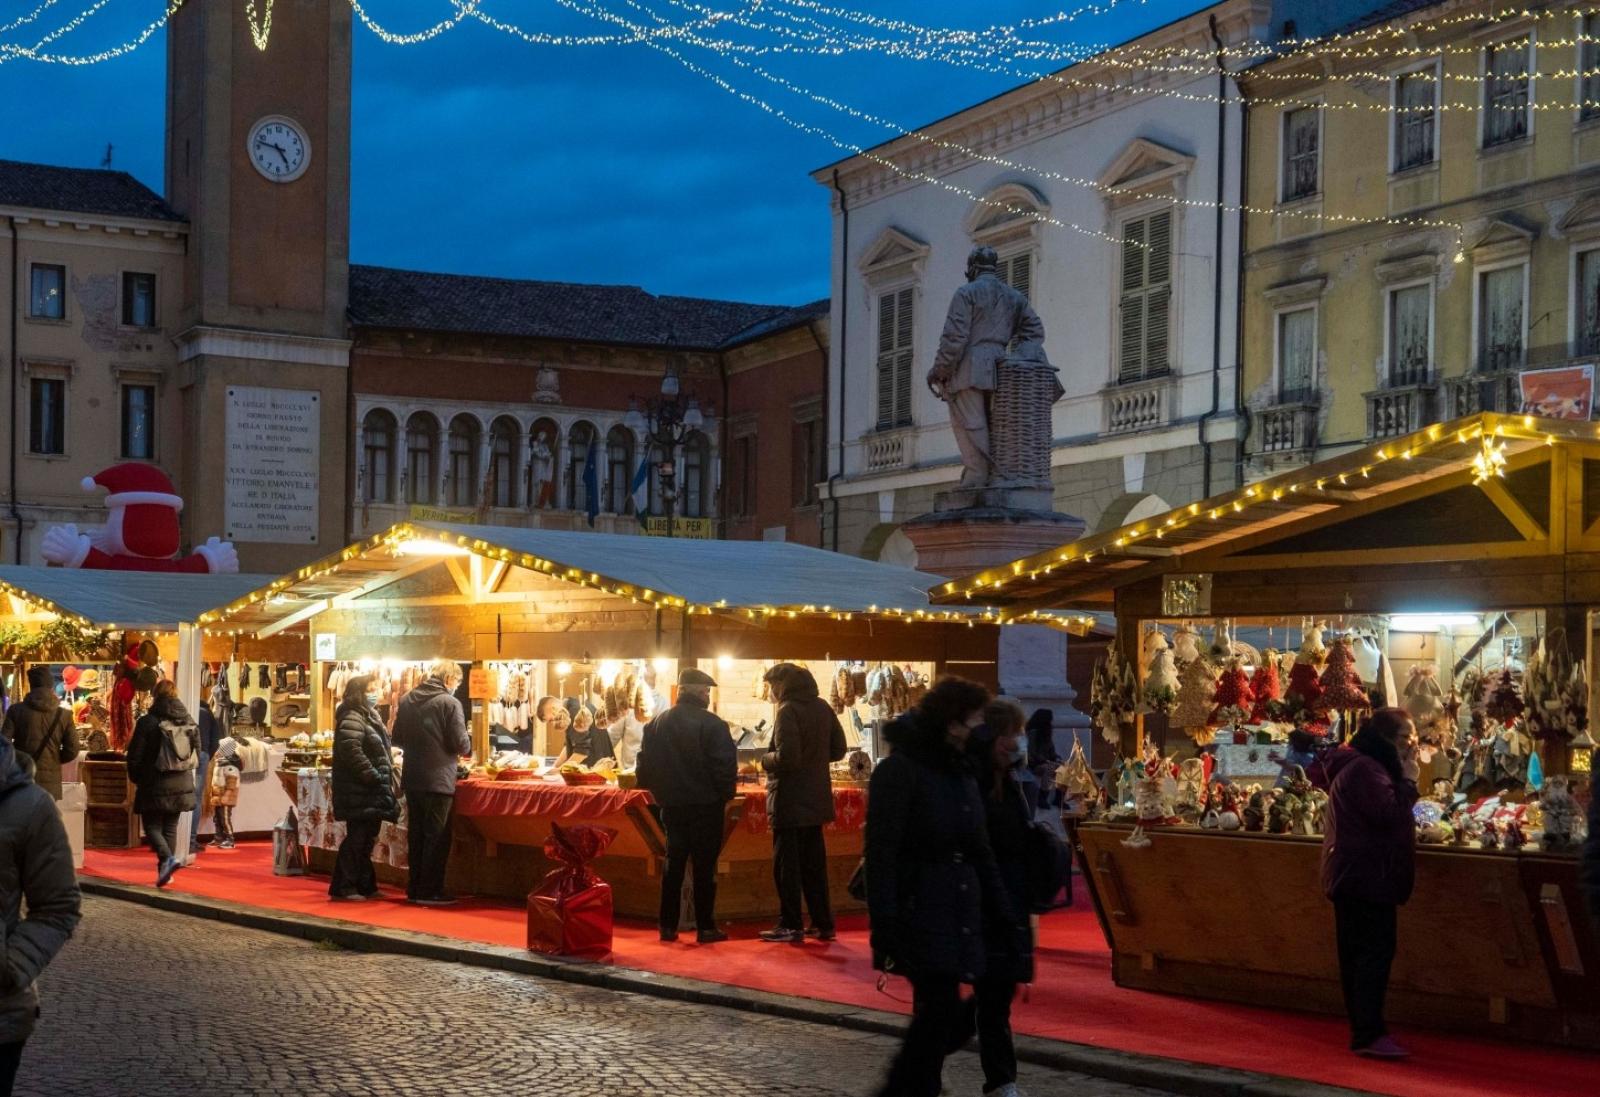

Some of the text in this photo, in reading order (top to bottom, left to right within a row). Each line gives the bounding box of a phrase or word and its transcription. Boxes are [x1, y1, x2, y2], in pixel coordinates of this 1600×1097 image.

[275, 413, 303, 421] FAUSTO
[238, 422, 260, 430] DELLA
[249, 468, 274, 476] LUGLIO
[225, 478, 265, 487] VITTORIO
[648, 519, 702, 532] LIBETA PER
